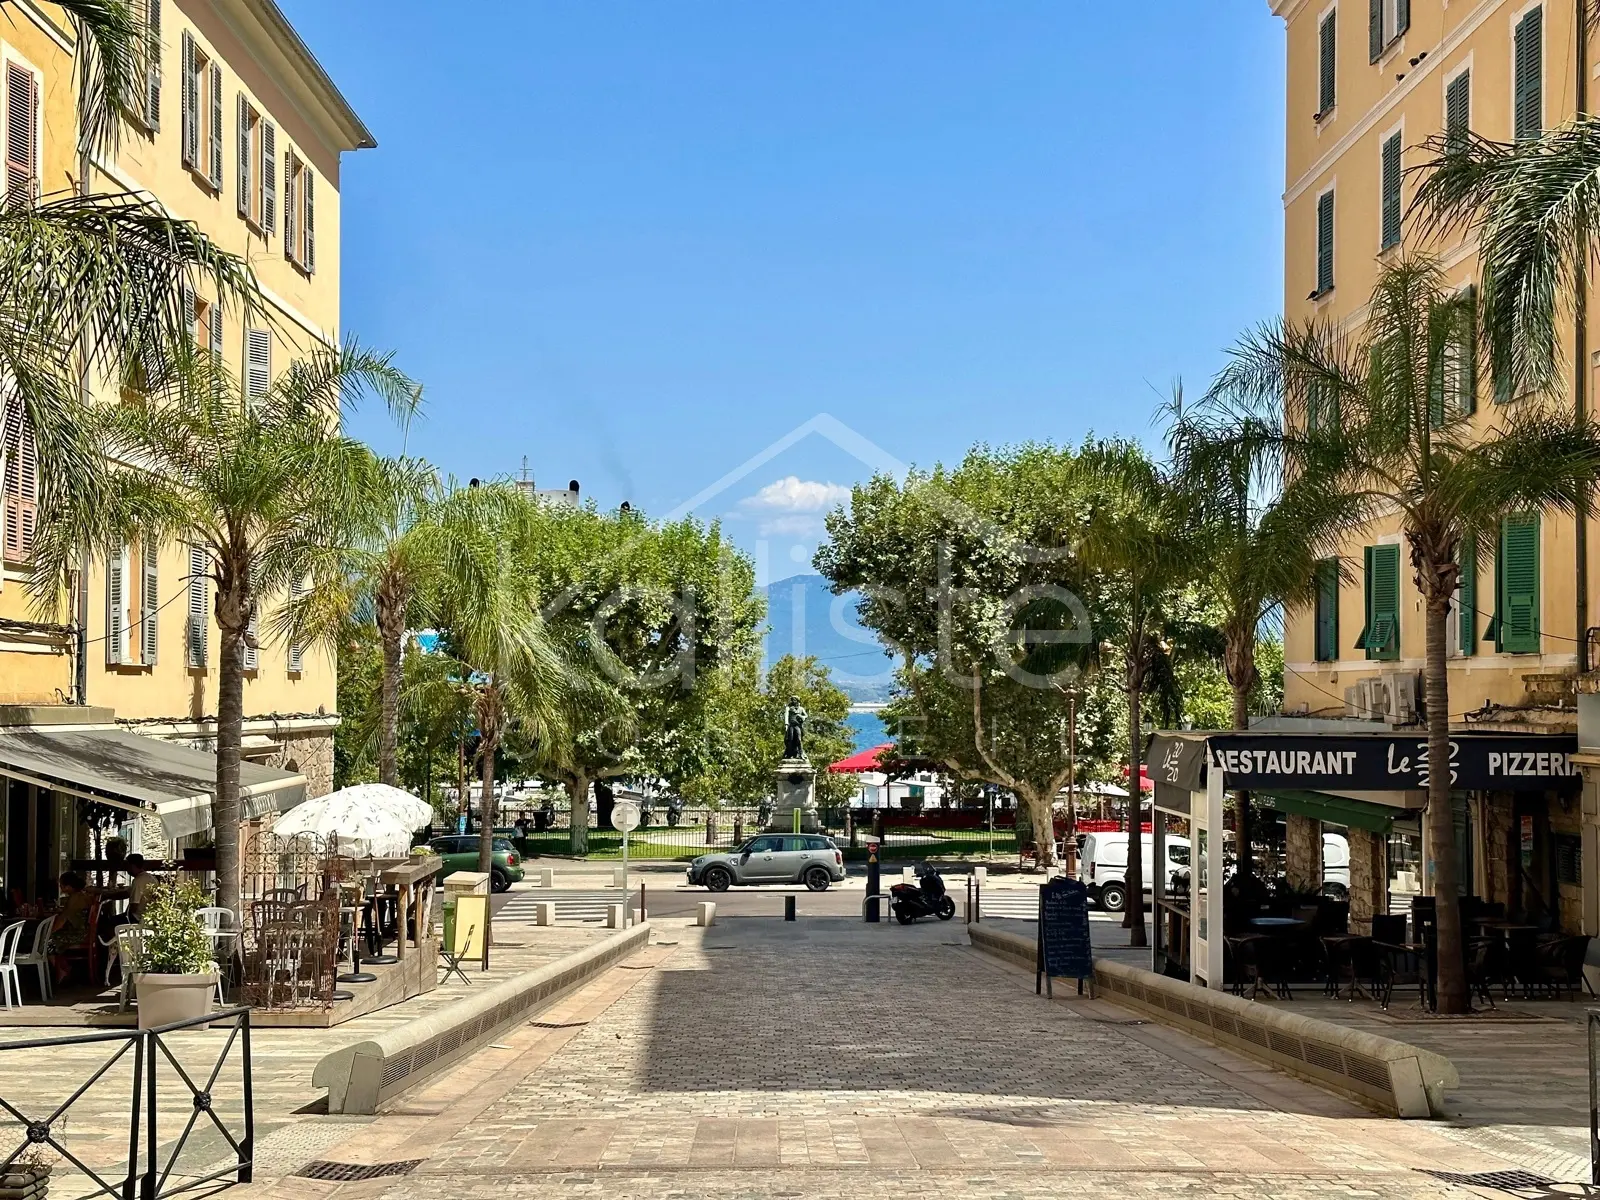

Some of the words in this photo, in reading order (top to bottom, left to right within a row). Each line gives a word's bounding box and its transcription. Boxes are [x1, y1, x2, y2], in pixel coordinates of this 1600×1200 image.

[1216, 749, 1357, 775] RESTAURANT
[1387, 742, 1411, 774] Le
[1166, 767, 1179, 783] 20
